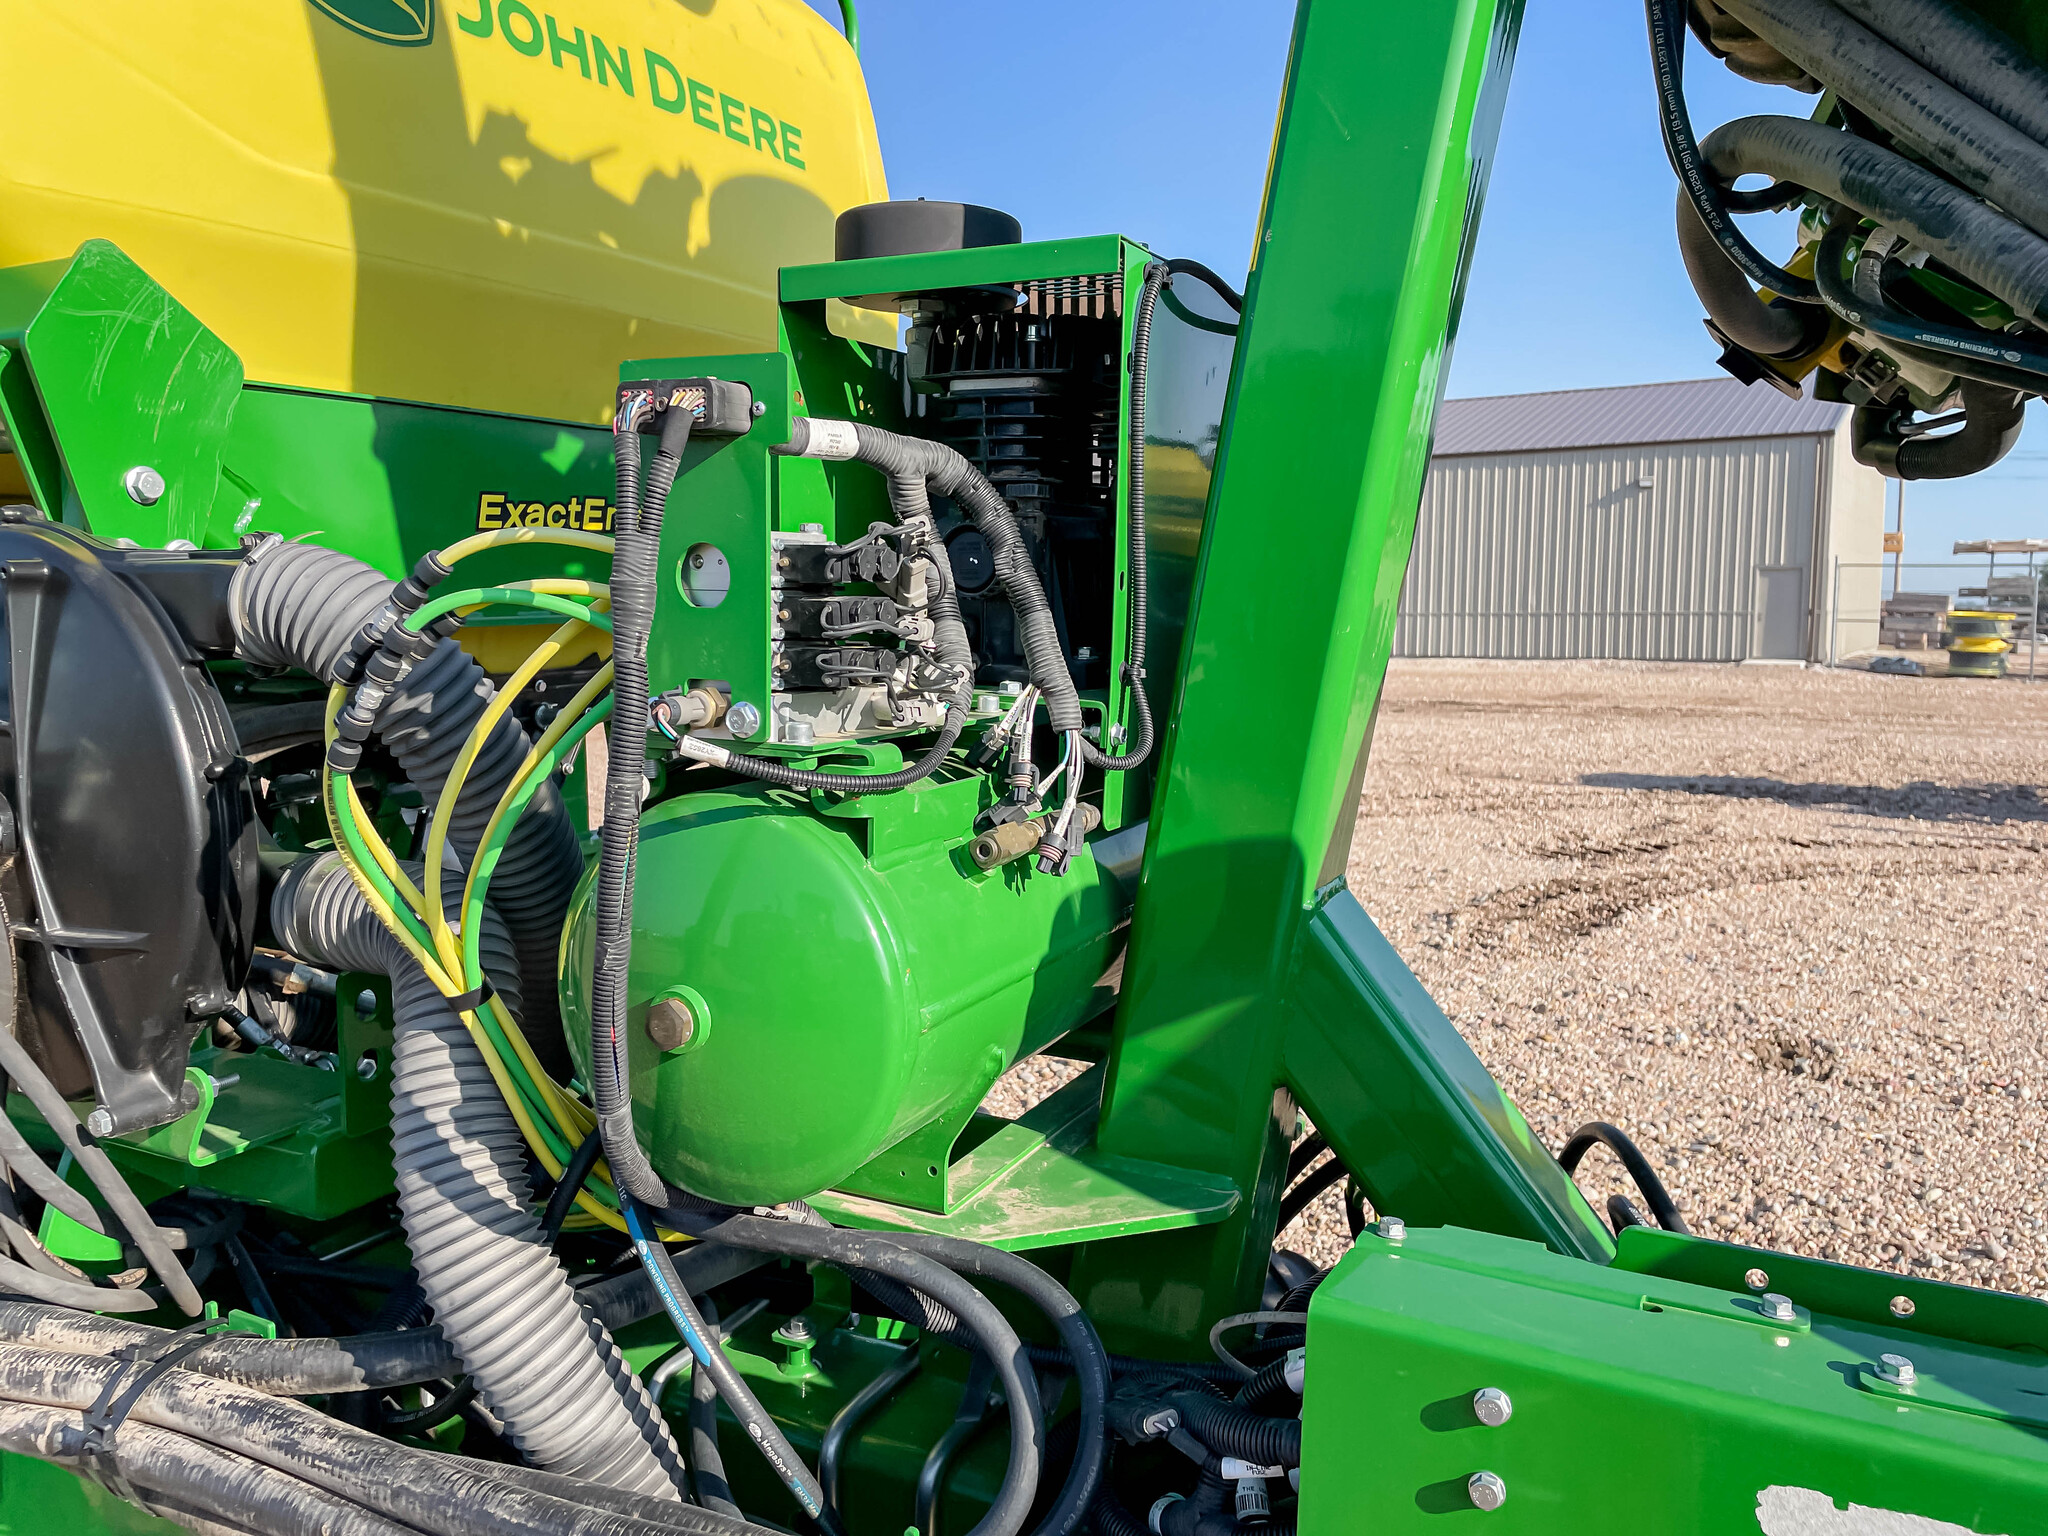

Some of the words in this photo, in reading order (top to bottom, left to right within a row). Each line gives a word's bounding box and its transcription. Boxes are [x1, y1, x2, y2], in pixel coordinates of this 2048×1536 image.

[457, 0, 635, 97] JOHN
[644, 48, 807, 170] DEERE
[1959, 341, 1999, 356] POWERING
[646, 1259, 667, 1295] POWERING
